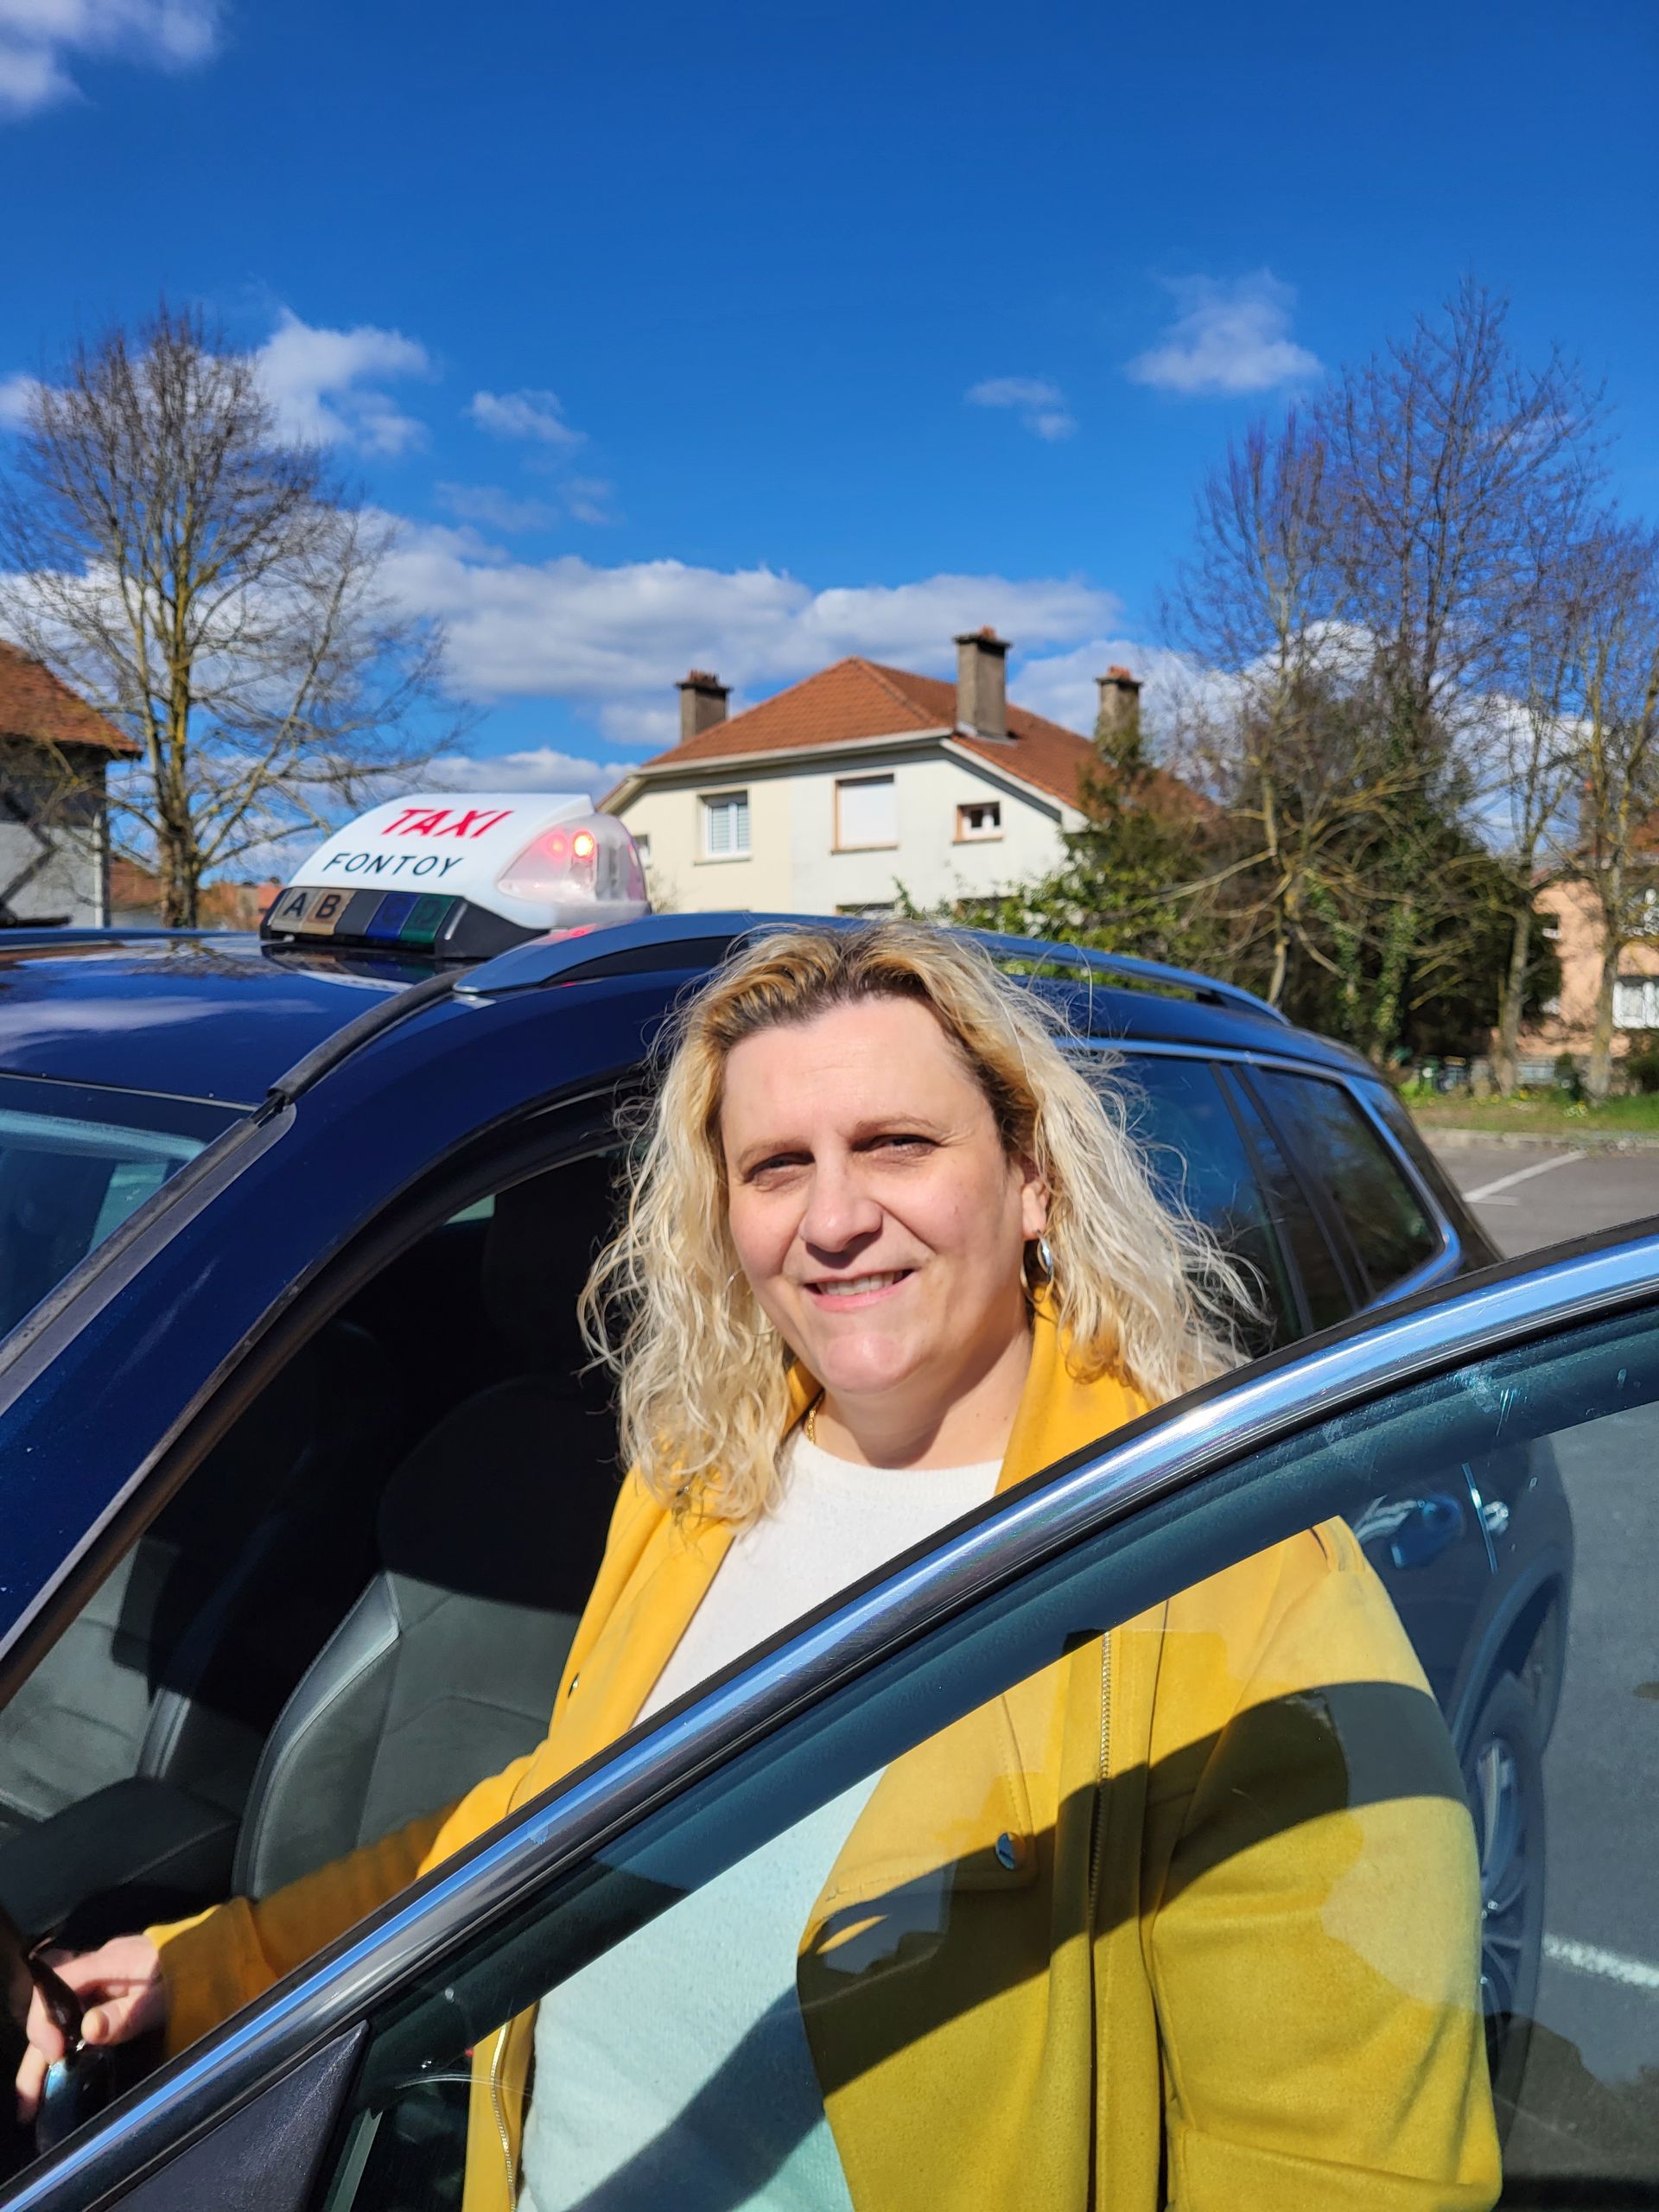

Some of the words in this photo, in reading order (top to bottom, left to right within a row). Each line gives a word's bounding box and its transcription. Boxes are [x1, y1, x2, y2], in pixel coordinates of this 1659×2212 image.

[380, 808, 514, 839] TAXI
[321, 853, 464, 878] FONTOY
[283, 893, 308, 918] A
[315, 893, 341, 919] B
